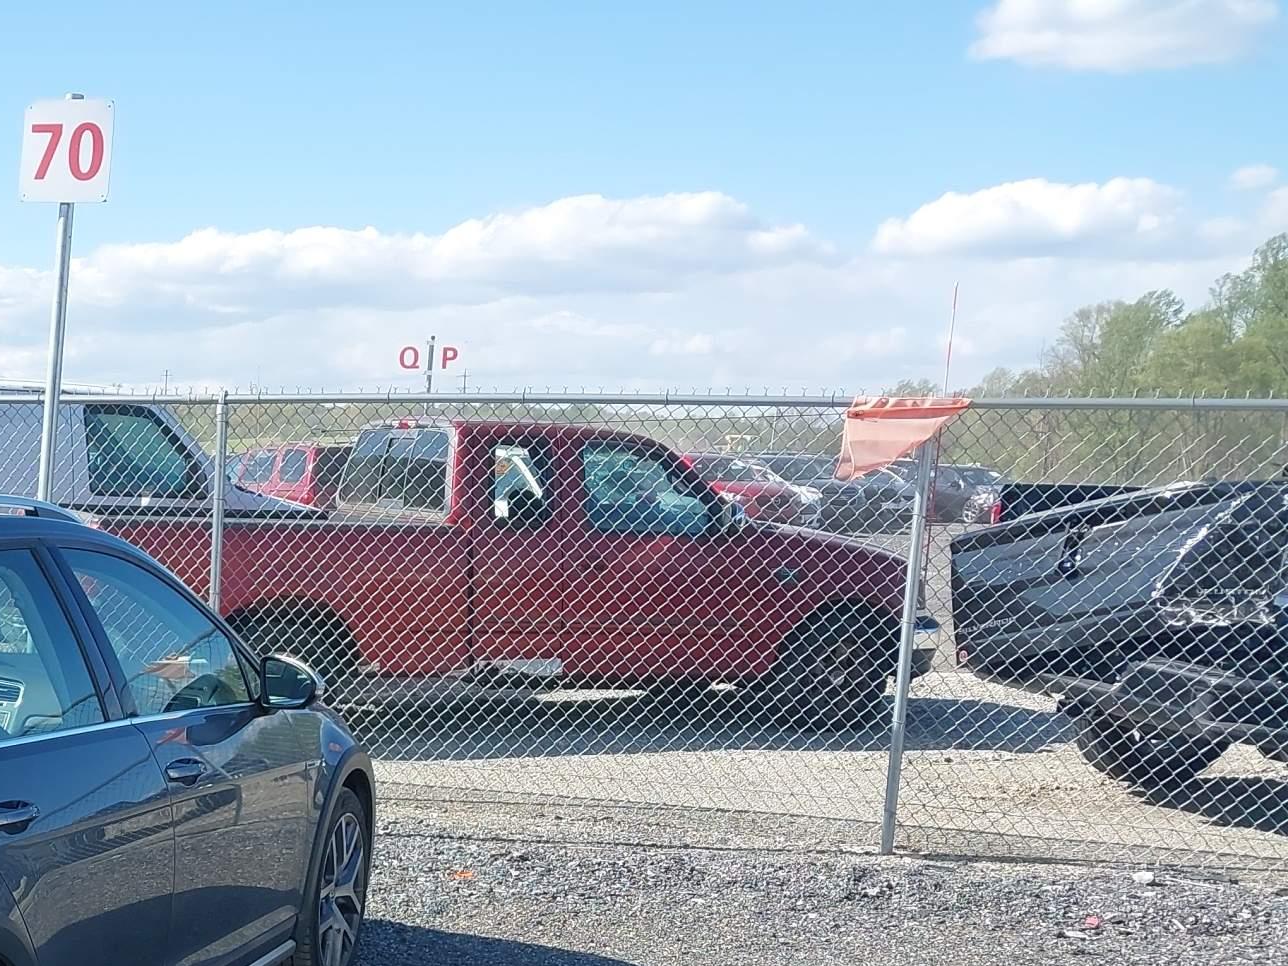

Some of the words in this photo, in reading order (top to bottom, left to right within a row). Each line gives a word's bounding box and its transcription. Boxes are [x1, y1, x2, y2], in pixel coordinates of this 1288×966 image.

[31, 122, 104, 181] 70
[399, 346, 420, 369] Q
[441, 347, 458, 369] P
